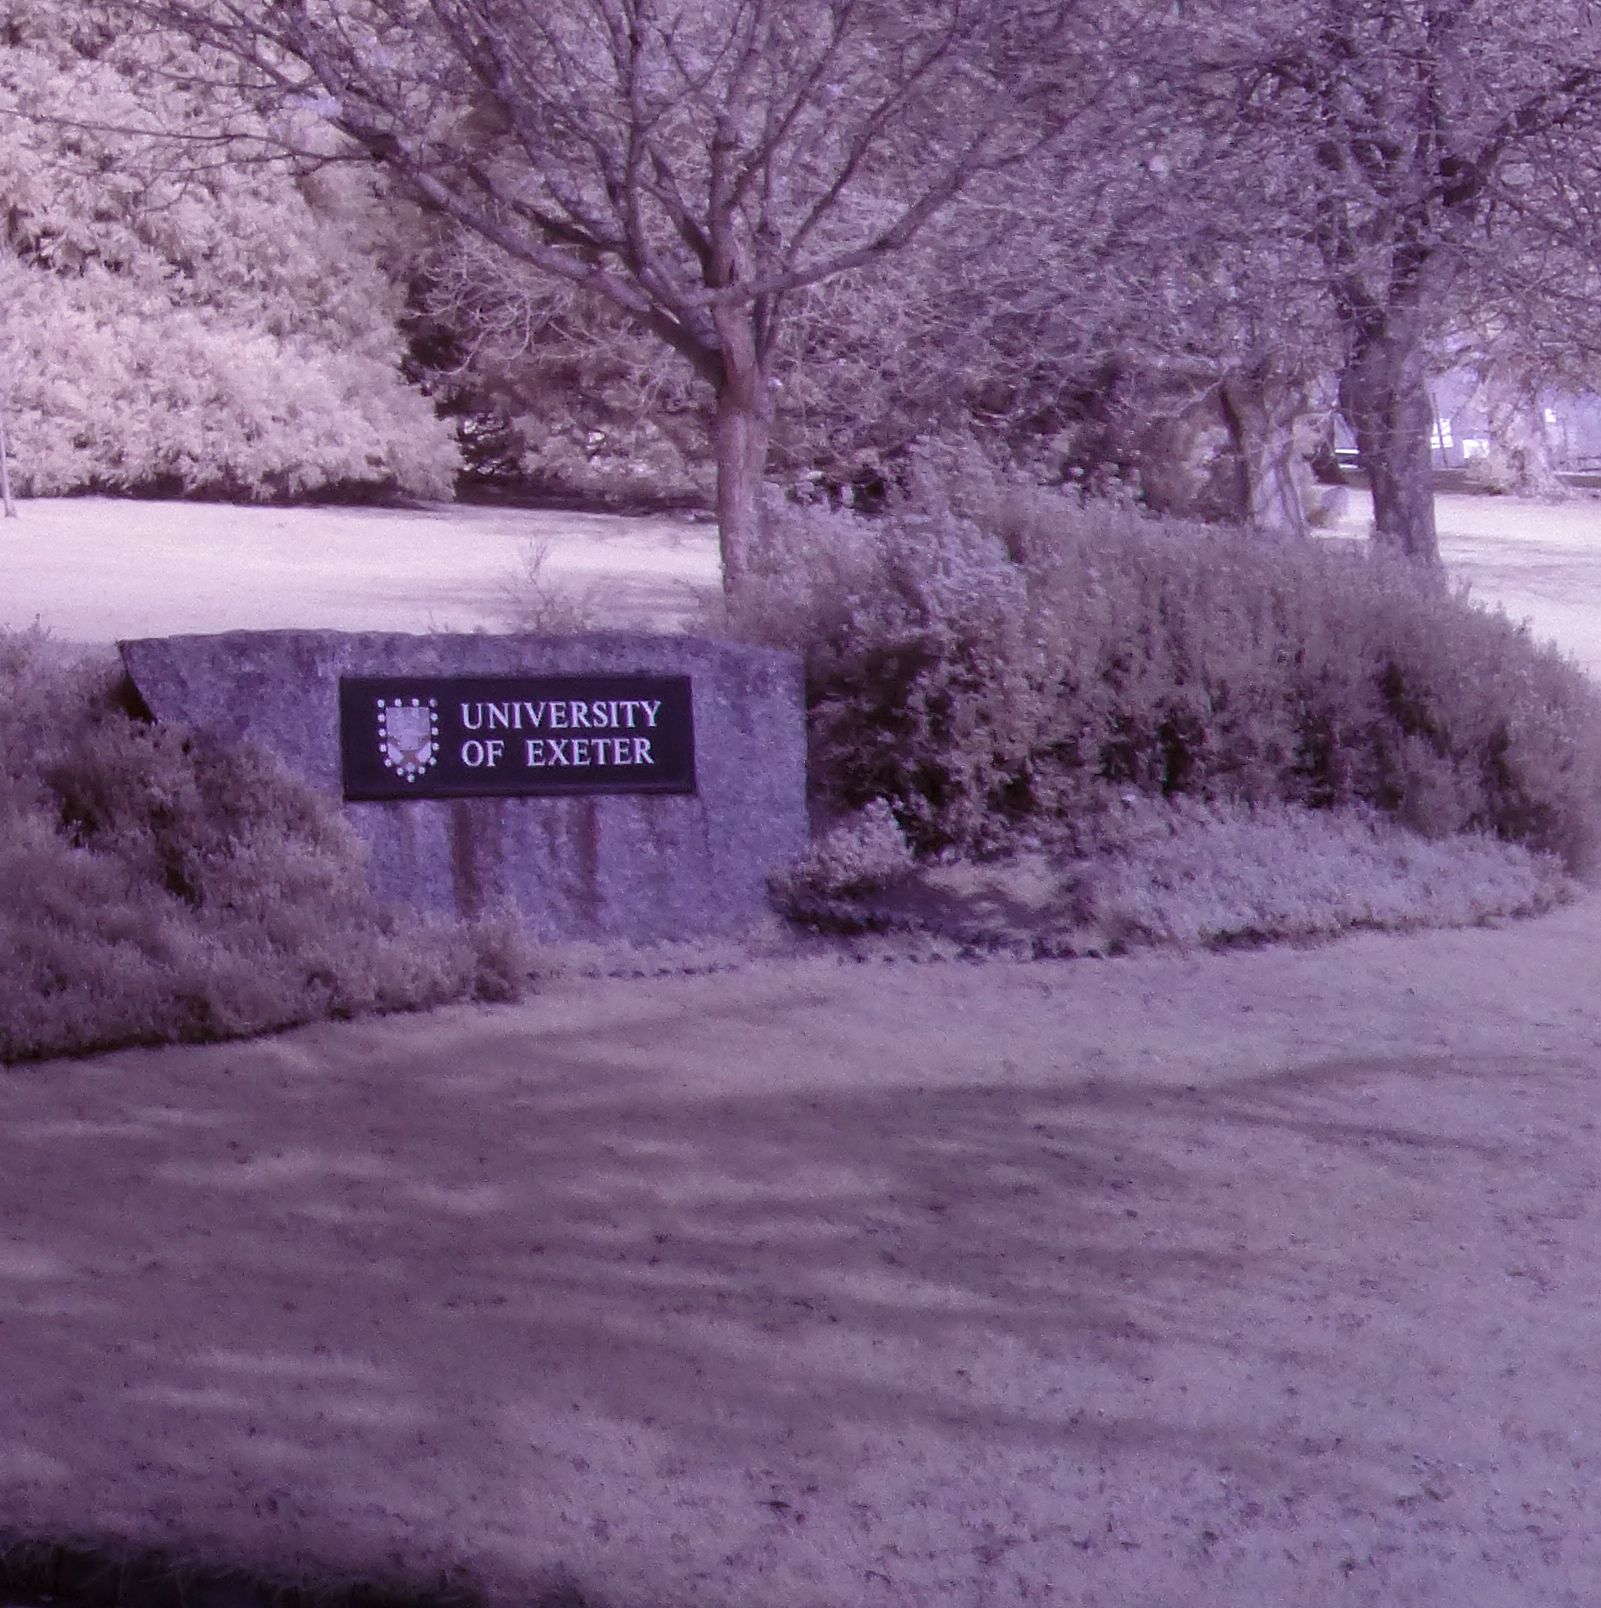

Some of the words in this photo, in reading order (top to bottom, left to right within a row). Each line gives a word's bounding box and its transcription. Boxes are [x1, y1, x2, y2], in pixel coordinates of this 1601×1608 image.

[461, 700, 661, 730] UNIVERSITY
[461, 739, 504, 767] OF
[525, 737, 654, 766] EXETER
